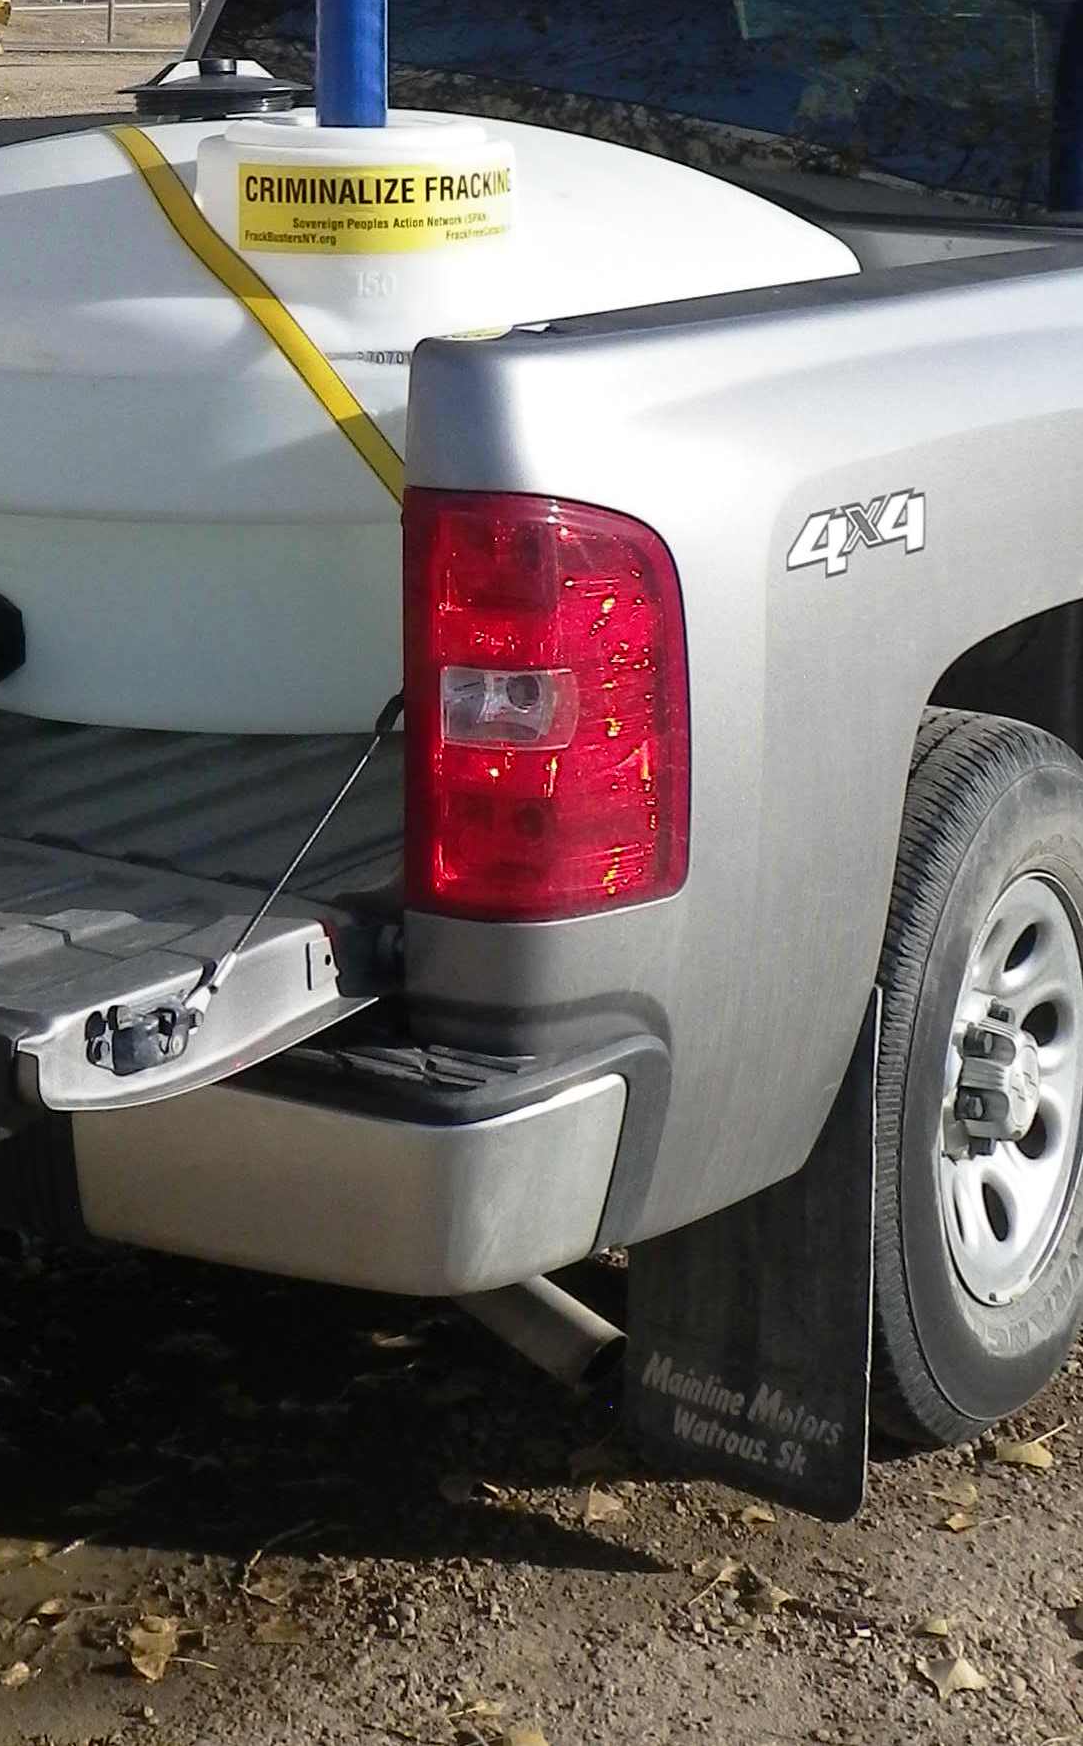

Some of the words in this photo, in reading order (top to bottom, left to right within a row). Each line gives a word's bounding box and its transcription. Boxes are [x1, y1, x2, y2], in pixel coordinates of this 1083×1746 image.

[245, 175, 415, 205] CRIMINALIZE
[293, 217, 344, 231] Sovereign
[347, 218, 389, 230] Peoples
[393, 217, 424, 228] Action
[427, 215, 462, 228] Network
[244, 230, 337, 246] FrackBustersNY.org
[642, 1351, 745, 1416] Mainline
[747, 1382, 843, 1445] Motors
